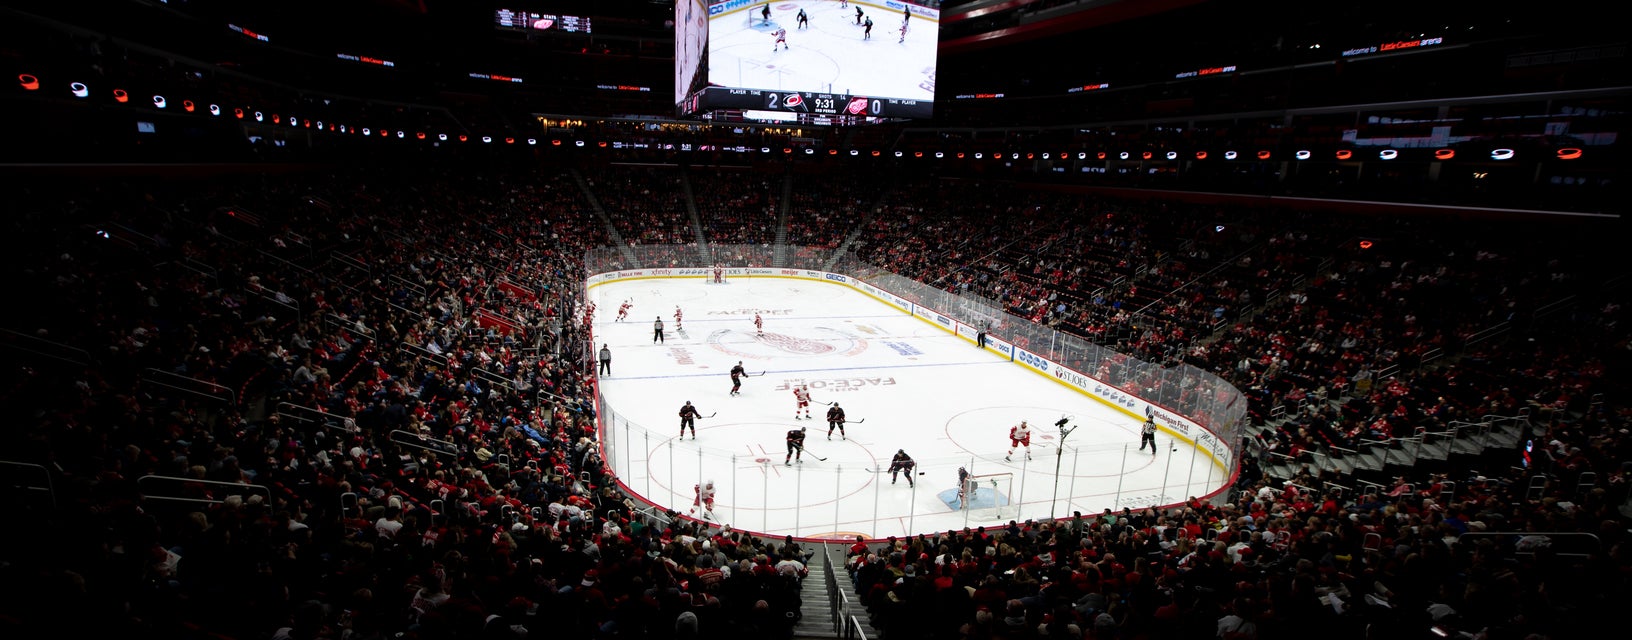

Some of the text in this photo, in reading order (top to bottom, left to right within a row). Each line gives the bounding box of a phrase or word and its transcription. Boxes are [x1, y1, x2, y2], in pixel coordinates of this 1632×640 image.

[1342, 46, 1369, 56] welcome
[769, 92, 777, 108] 2
[815, 99, 833, 109] 9:31
[872, 100, 880, 114] 0
[1154, 410, 1189, 431] Michigan First
